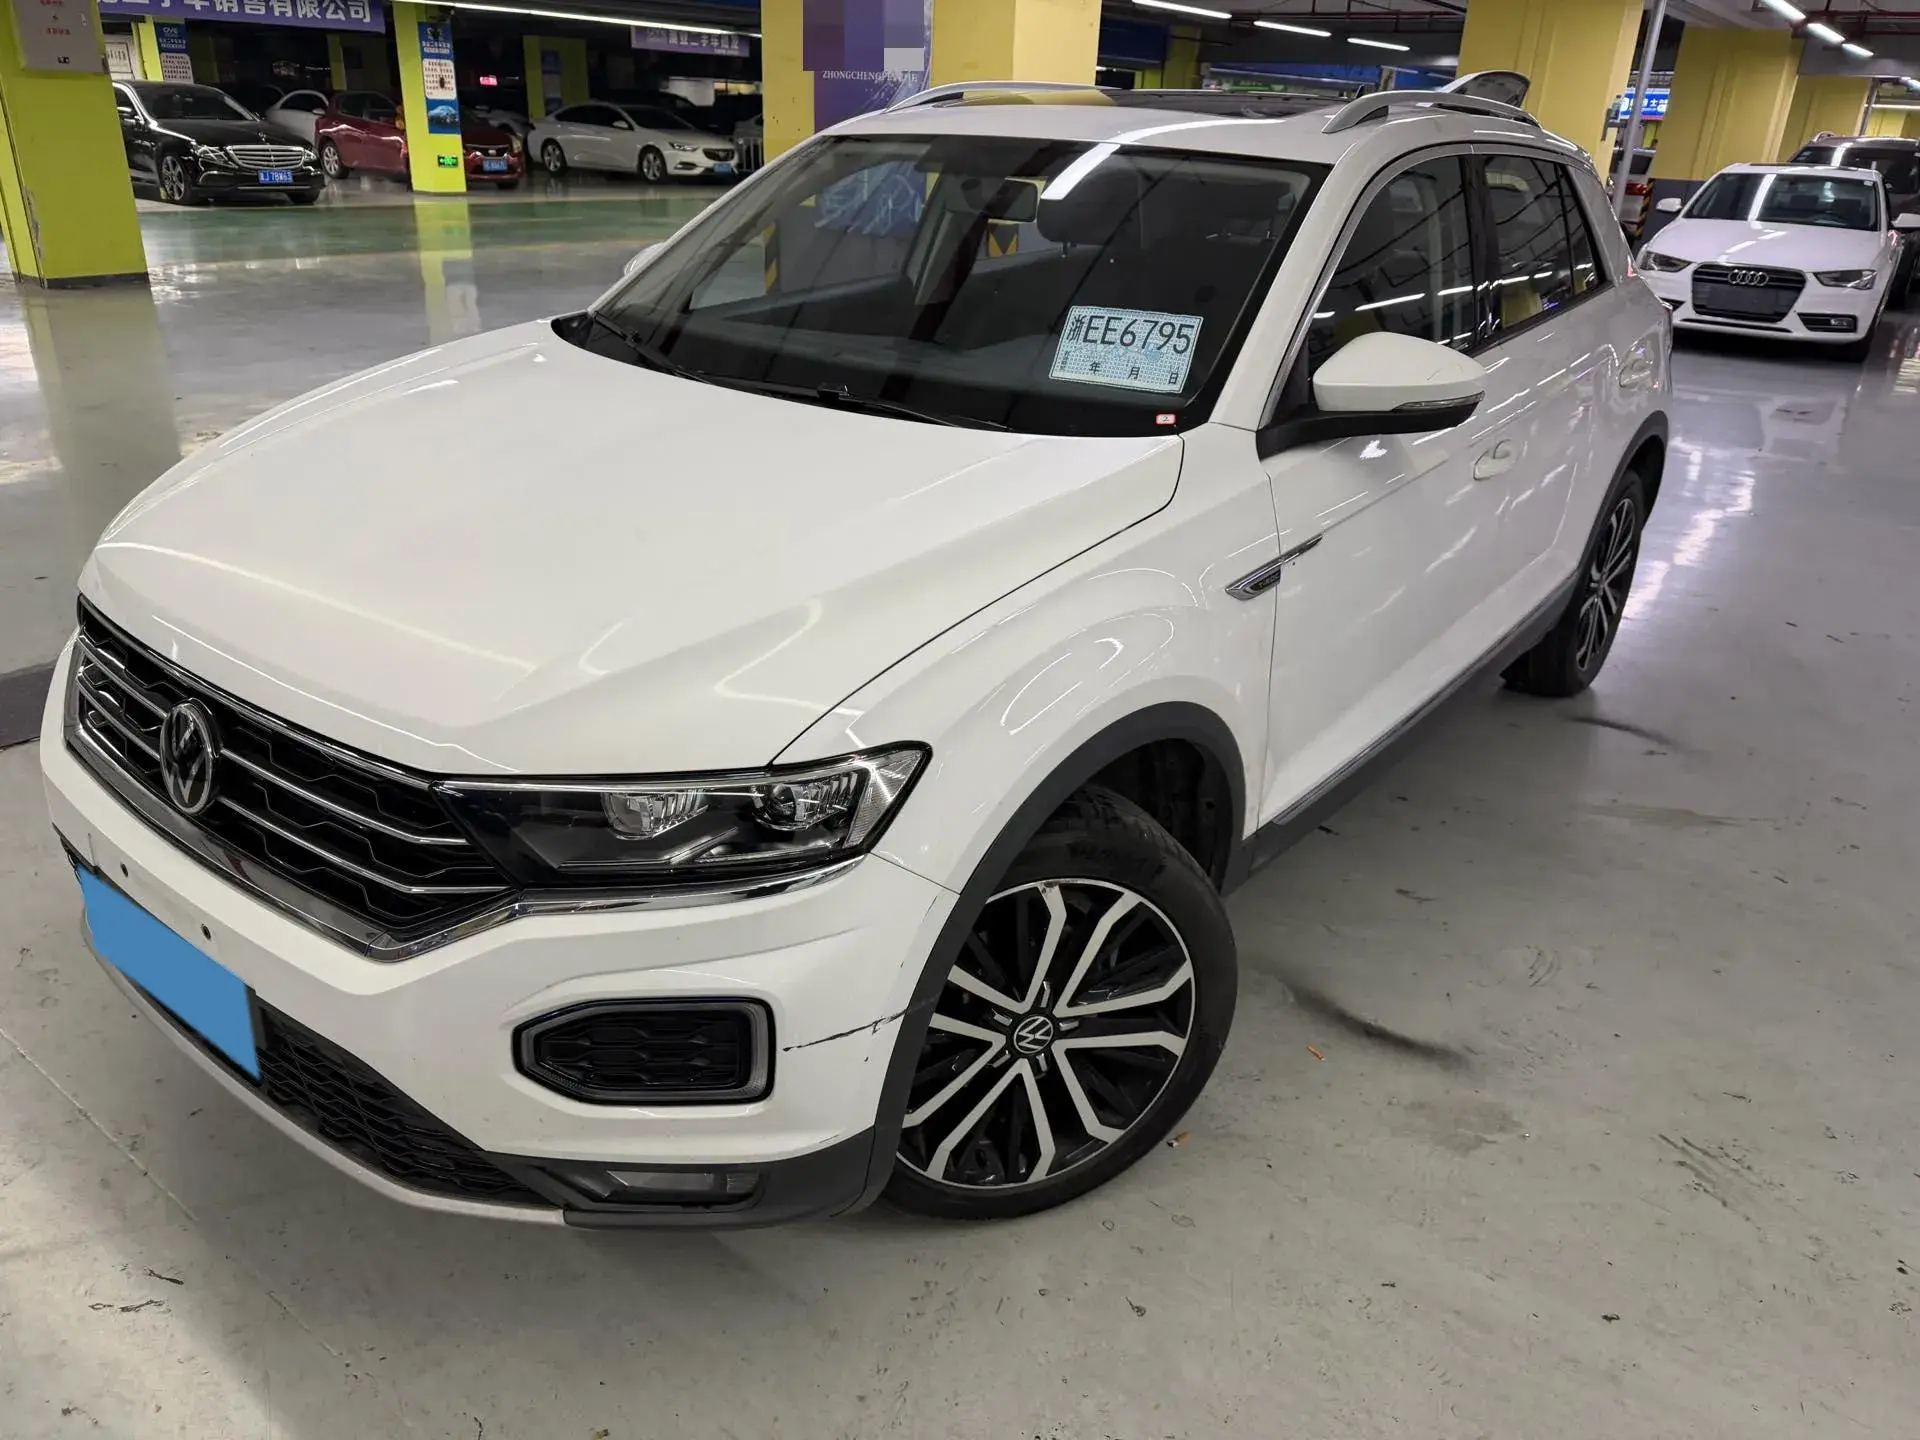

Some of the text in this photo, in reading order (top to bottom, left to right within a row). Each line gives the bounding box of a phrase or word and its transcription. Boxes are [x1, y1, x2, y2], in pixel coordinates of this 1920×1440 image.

[1066, 314, 1195, 355] 浙EE6795
[1089, 361, 1180, 385] 年 月 日
